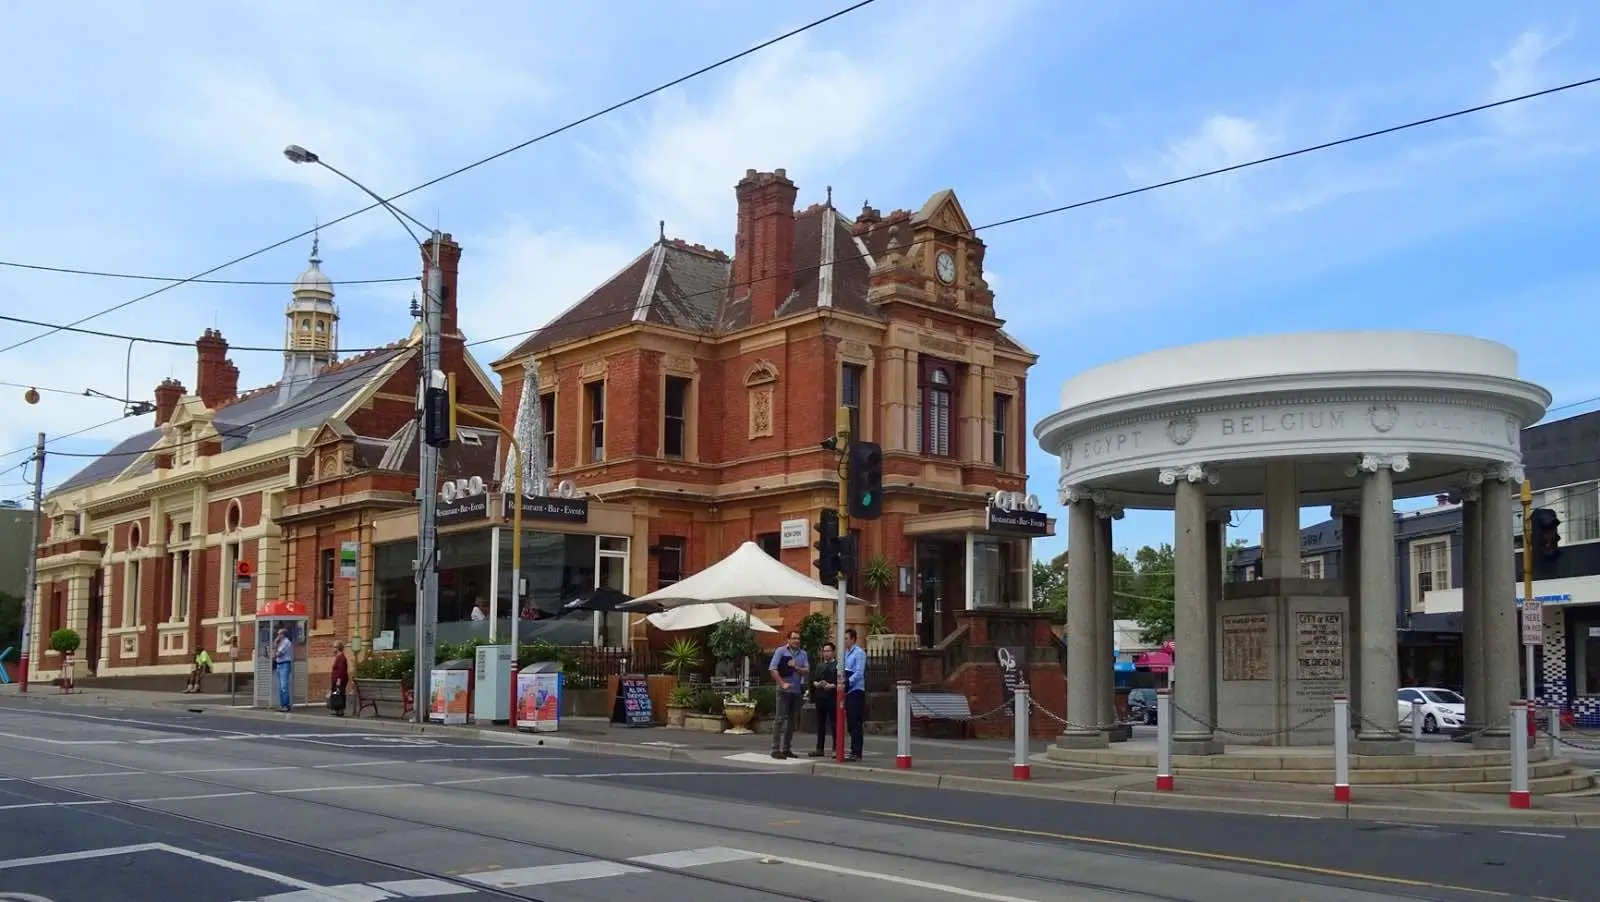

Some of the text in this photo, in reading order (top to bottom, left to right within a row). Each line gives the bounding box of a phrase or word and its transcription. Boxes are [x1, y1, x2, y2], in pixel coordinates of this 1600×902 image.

[1221, 410, 1346, 437] BELGIUM
[1083, 431, 1142, 459] EGYPT
[547, 504, 560, 513] Bar
[563, 505, 585, 515] Events
[1299, 615, 1315, 624] CITY
[1325, 615, 1340, 624] KEW
[1524, 613, 1541, 623] HERE
